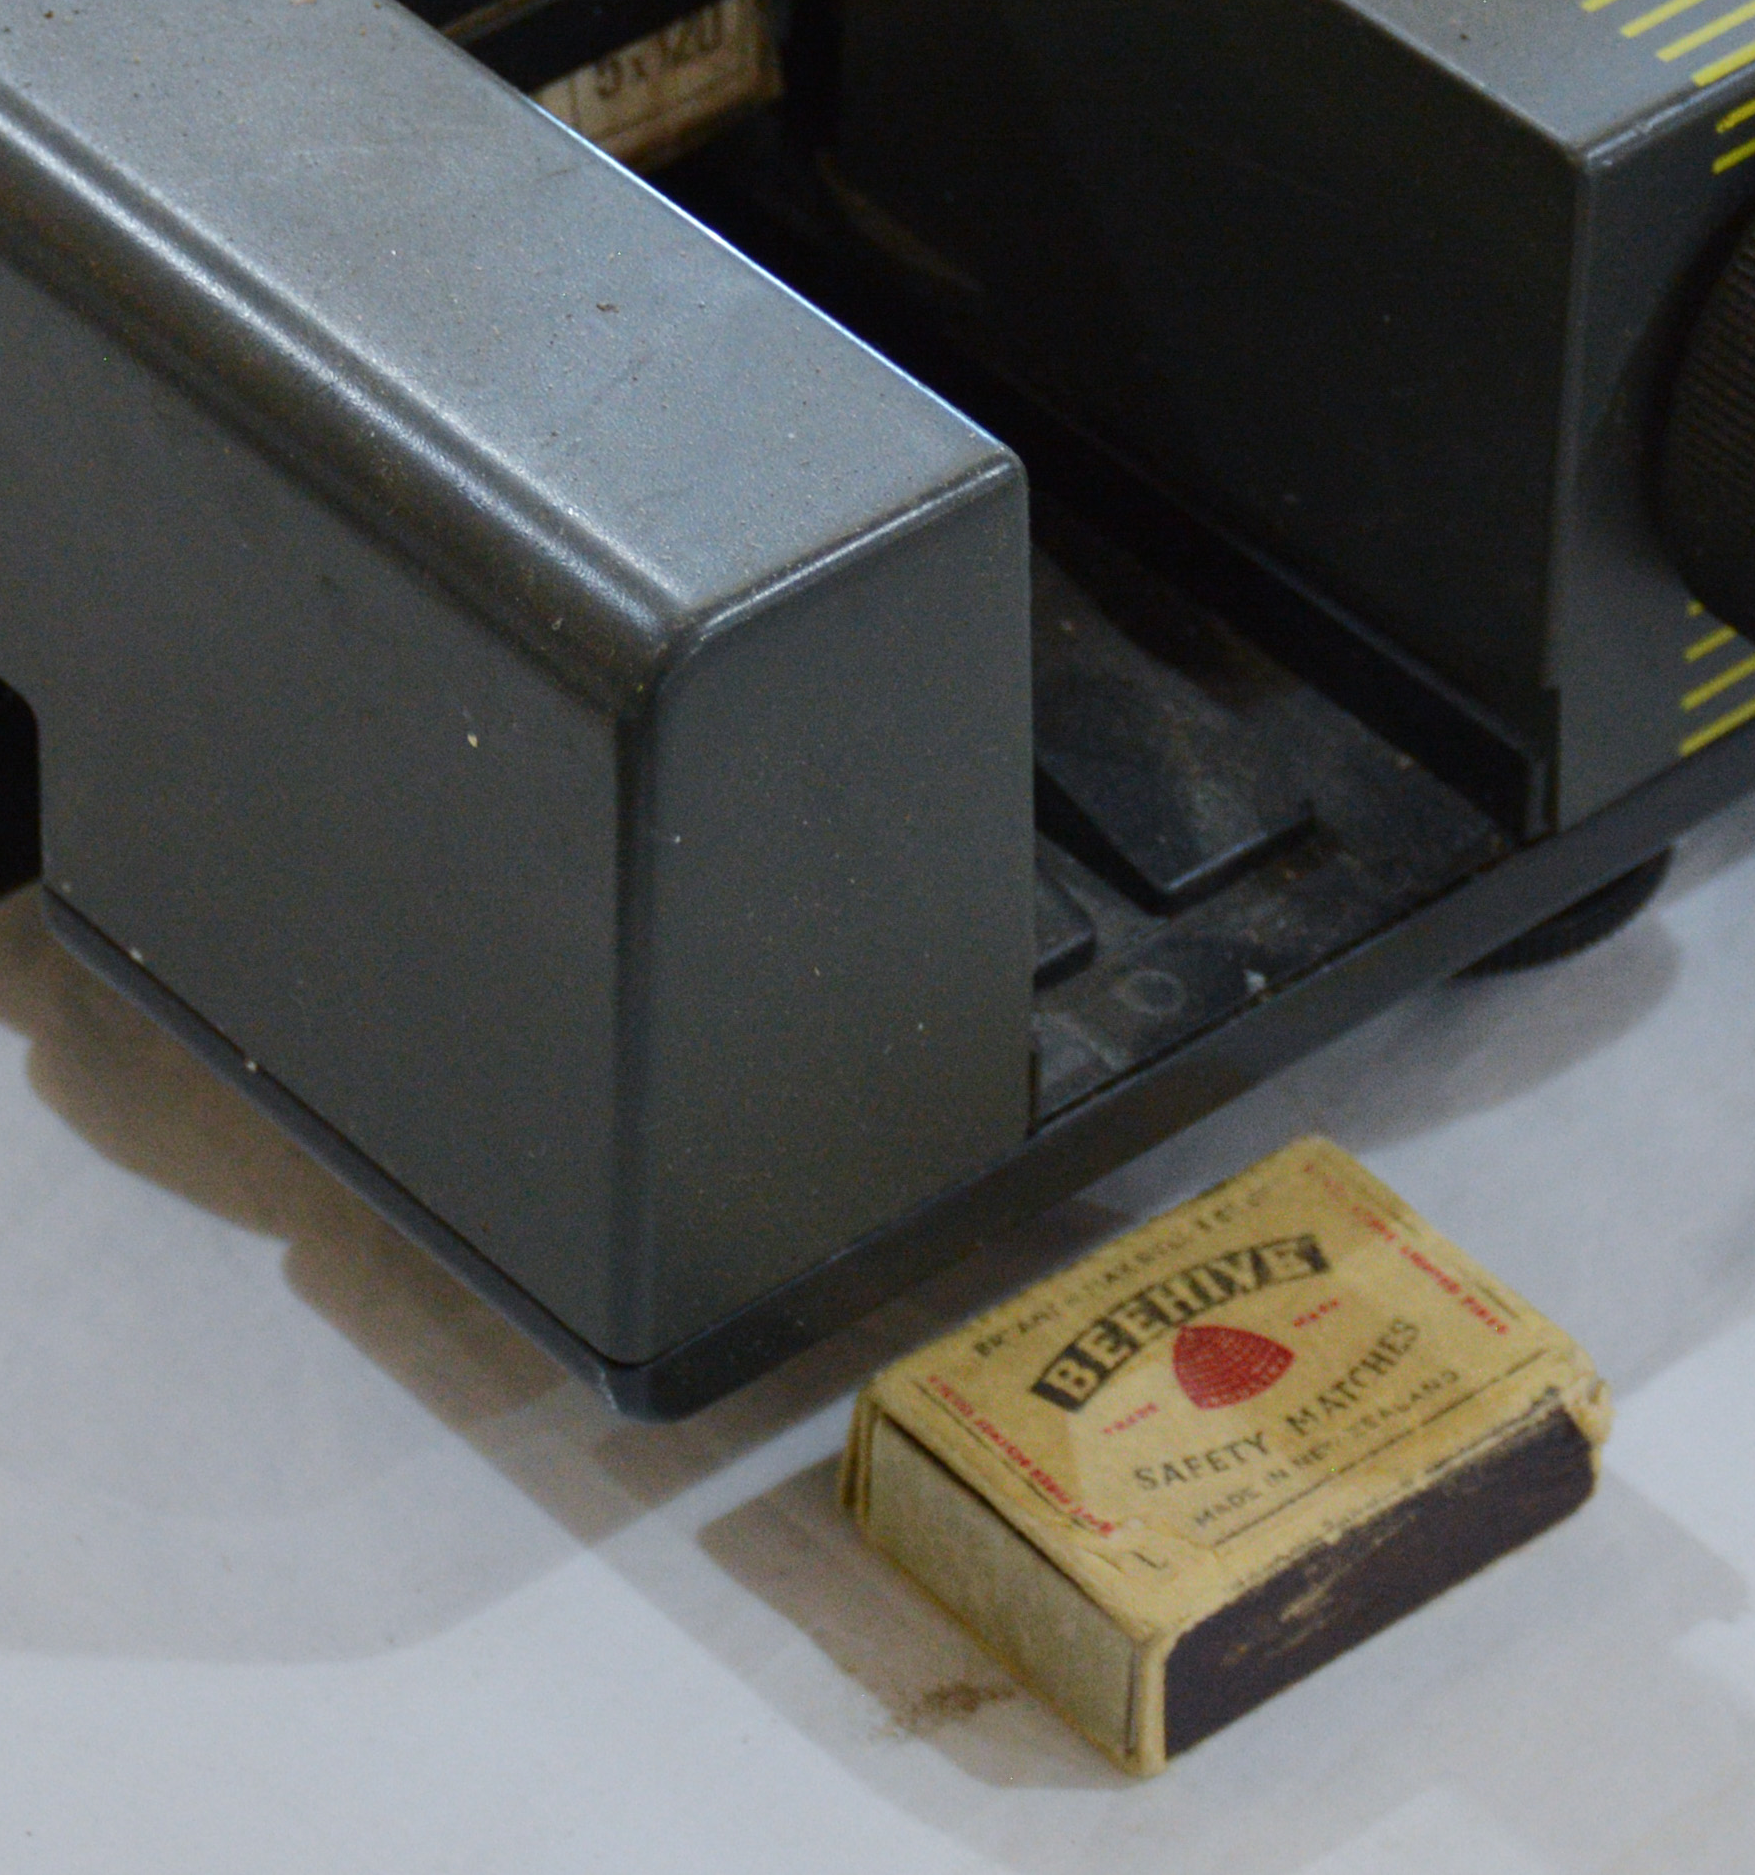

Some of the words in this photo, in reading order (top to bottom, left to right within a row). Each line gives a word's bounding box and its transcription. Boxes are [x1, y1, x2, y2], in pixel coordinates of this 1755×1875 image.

[1037, 1233, 1325, 1410] BEEHIVE
[1132, 1429, 1272, 1492] SAFETY
[1285, 1315, 1422, 1438] MATCHES
[1195, 1487, 1263, 1527] MADE
[1265, 1467, 1292, 1488] IN
